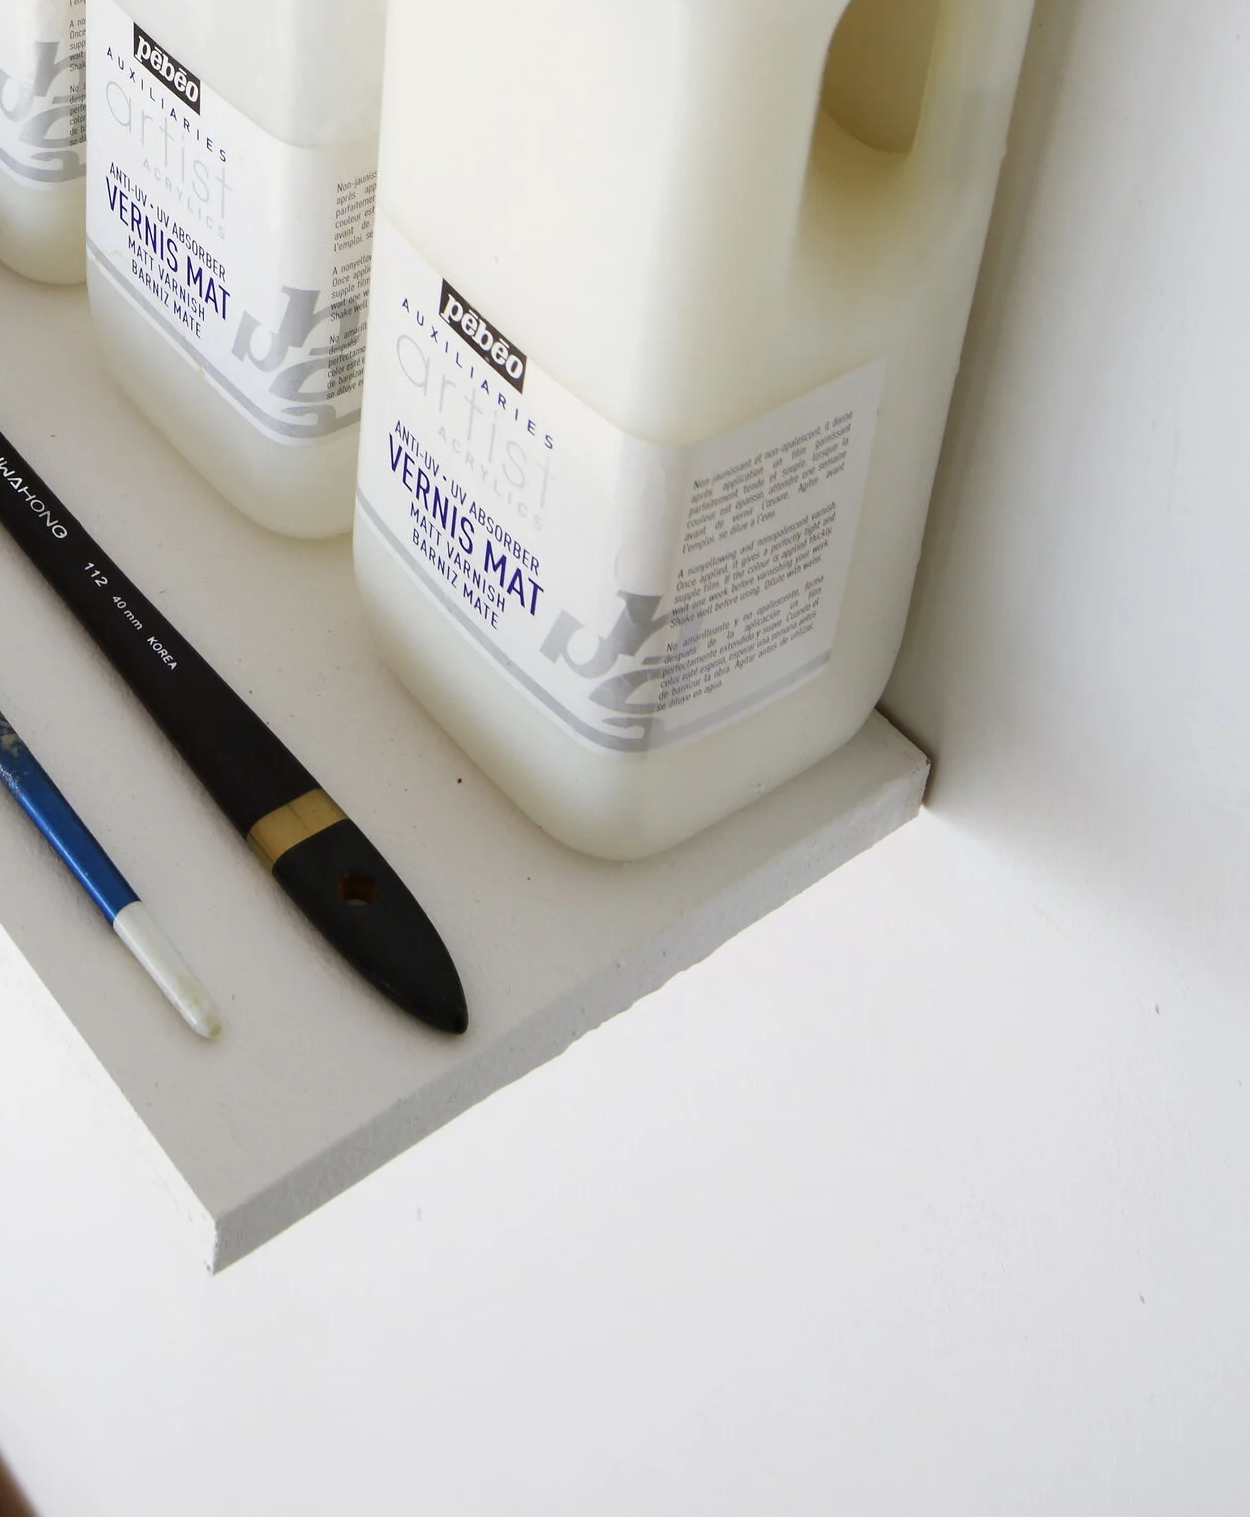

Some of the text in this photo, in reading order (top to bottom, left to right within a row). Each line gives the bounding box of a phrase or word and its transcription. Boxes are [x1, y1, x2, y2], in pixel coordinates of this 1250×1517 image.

[107, 46, 227, 162] AUXILIARIES
[106, 80, 232, 219] artist
[109, 162, 226, 282] ANTI-UV UV ABSORBER
[334, 220, 370, 241] avant de
[335, 206, 375, 229] couleur est
[105, 176, 231, 321] VERNIS MAT
[332, 266, 338, 276] A
[128, 235, 205, 321] MATT VARNISH
[131, 259, 201, 339] BARNIZ MATE
[330, 293, 361, 311] wait one
[331, 284, 355, 299] supple
[332, 275, 350, 288] Once
[330, 299, 369, 322] Shake well
[330, 334, 340, 344] No
[402, 298, 554, 449] AUXILIARIES
[397, 334, 559, 509] artist
[388, 433, 544, 616] VERNIS MAT
[395, 420, 540, 575] ANTI-UV UV ABSORBER
[410, 502, 506, 612] MATT VARNISH
[413, 528, 499, 630] BARNIZ MATE
[676, 578, 696, 591] Once
[678, 569, 684, 579] A
[84, 562, 108, 587] 112
[112, 595, 126, 610] 40
[124, 608, 143, 631] mm
[146, 636, 178, 671] KOREA
[670, 614, 695, 628] Shake
[697, 604, 712, 619] well
[714, 595, 738, 611] before
[675, 588, 700, 604] supple
[667, 642, 678, 652] No
